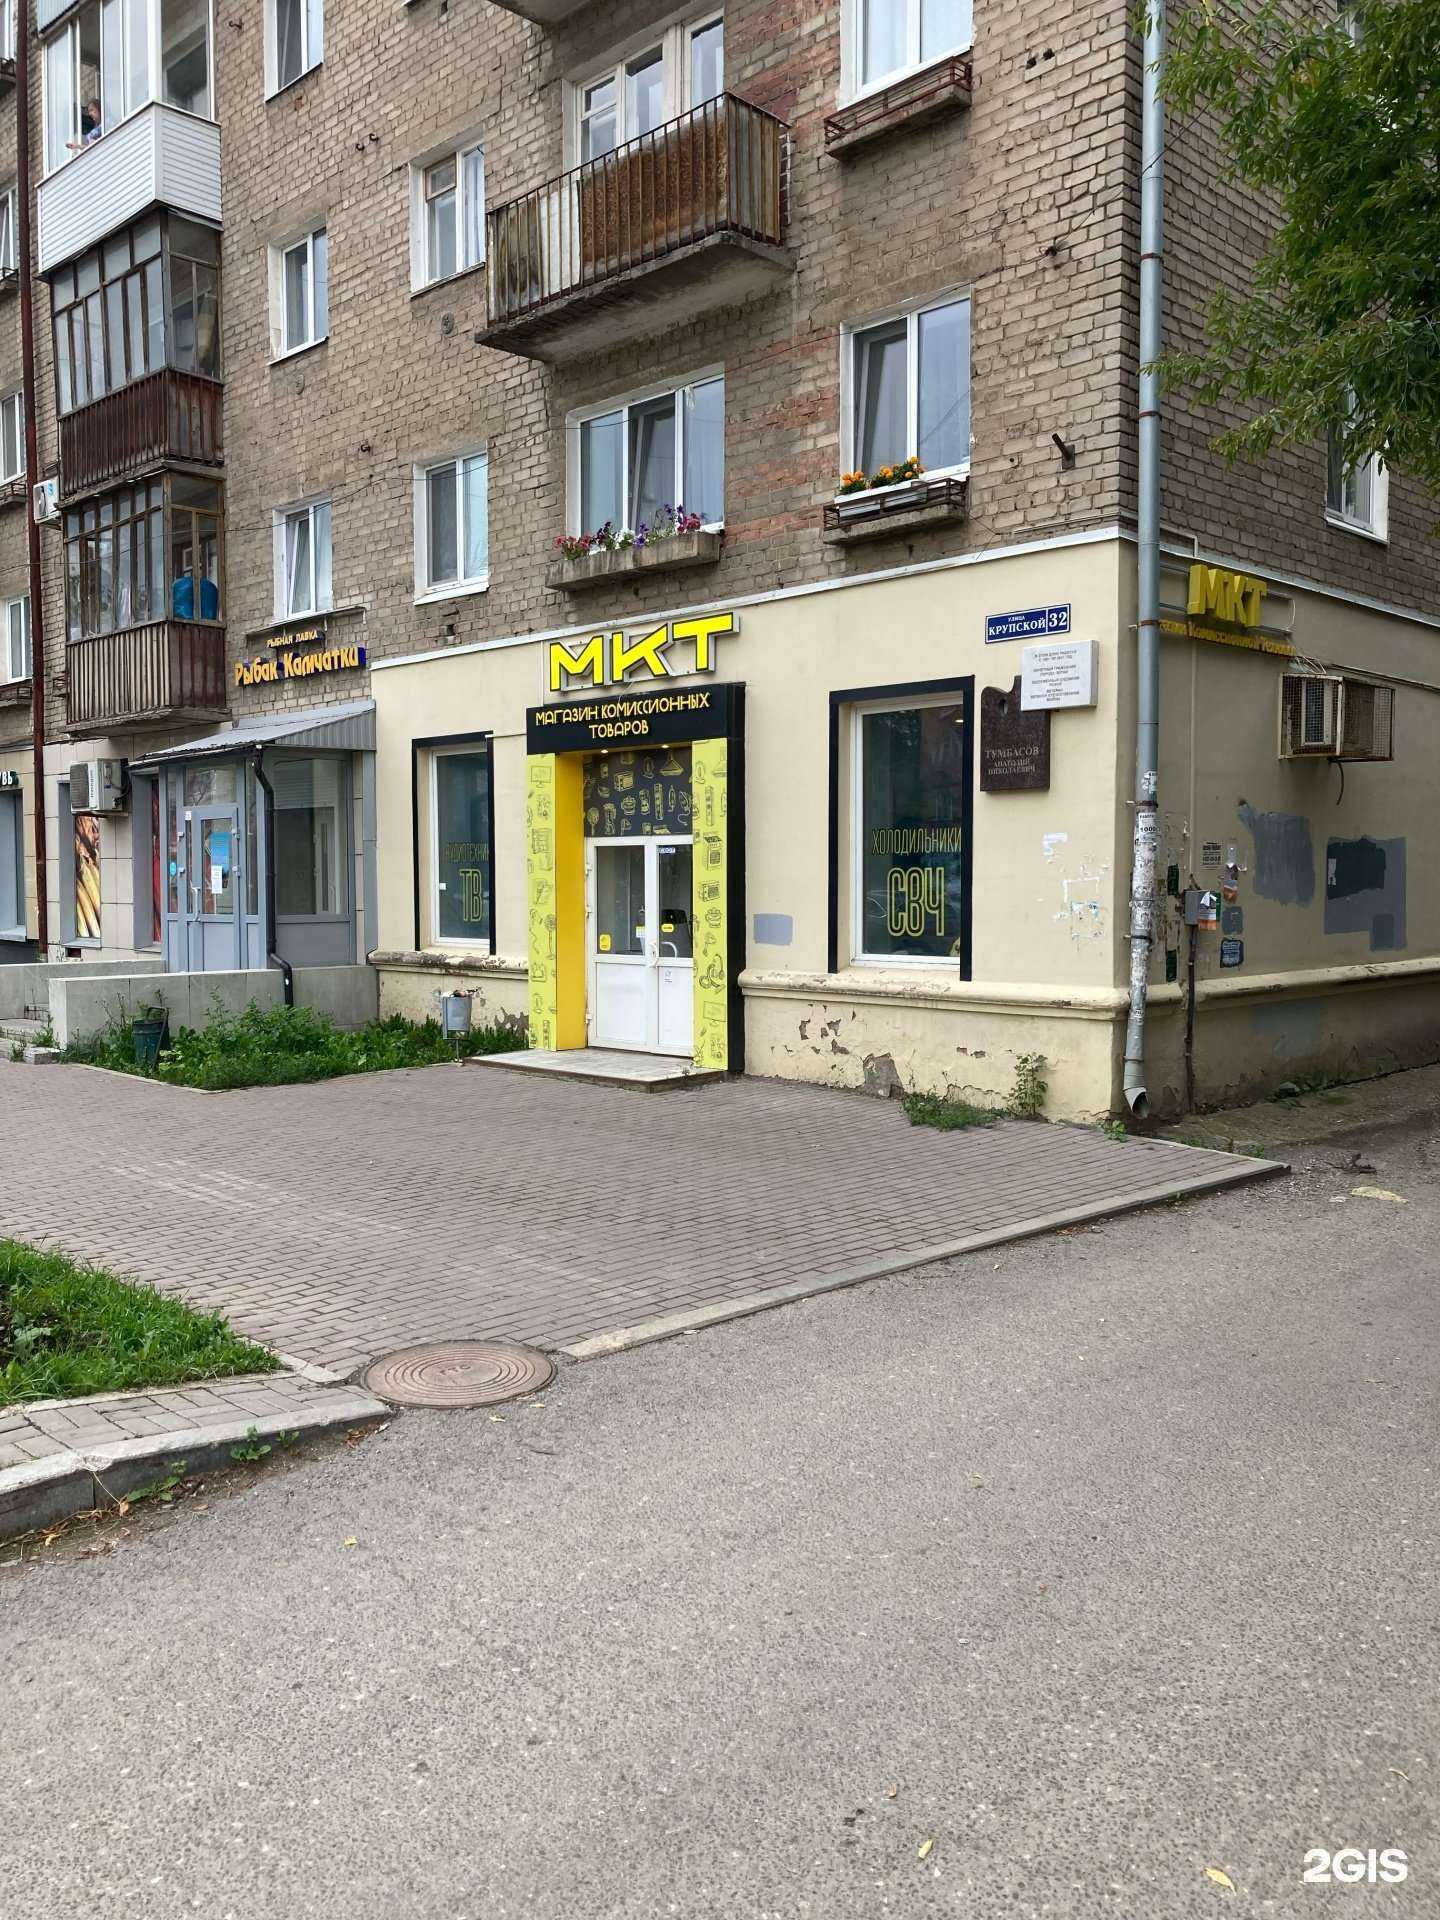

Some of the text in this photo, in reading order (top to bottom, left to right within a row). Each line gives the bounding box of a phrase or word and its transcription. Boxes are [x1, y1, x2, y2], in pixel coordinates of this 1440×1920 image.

[1187, 564, 1267, 627] МКТ
[988, 617, 1046, 636] КРУПСКОЙ
[1008, 615, 1025, 623] УЛИЦА
[1049, 611, 1067, 628] 32
[267, 630, 318, 648] РЫБНАЯ ЛАВКА
[549, 612, 735, 691] МКТ
[234, 646, 359, 686] Рыбак Камчатки
[535, 692, 711, 726] МАГАЗИН КОМИССИОННЫХ
[589, 719, 649, 739] ТОВАРОВ
[985, 746, 1040, 759] ТУМБАСОВ
[0, 771, 12, 785] ВЬ
[872, 827, 961, 856] ХОЛОДИЛЬНИКИ
[459, 868, 482, 922] ТВ
[887, 867, 944, 936] СВЧ
